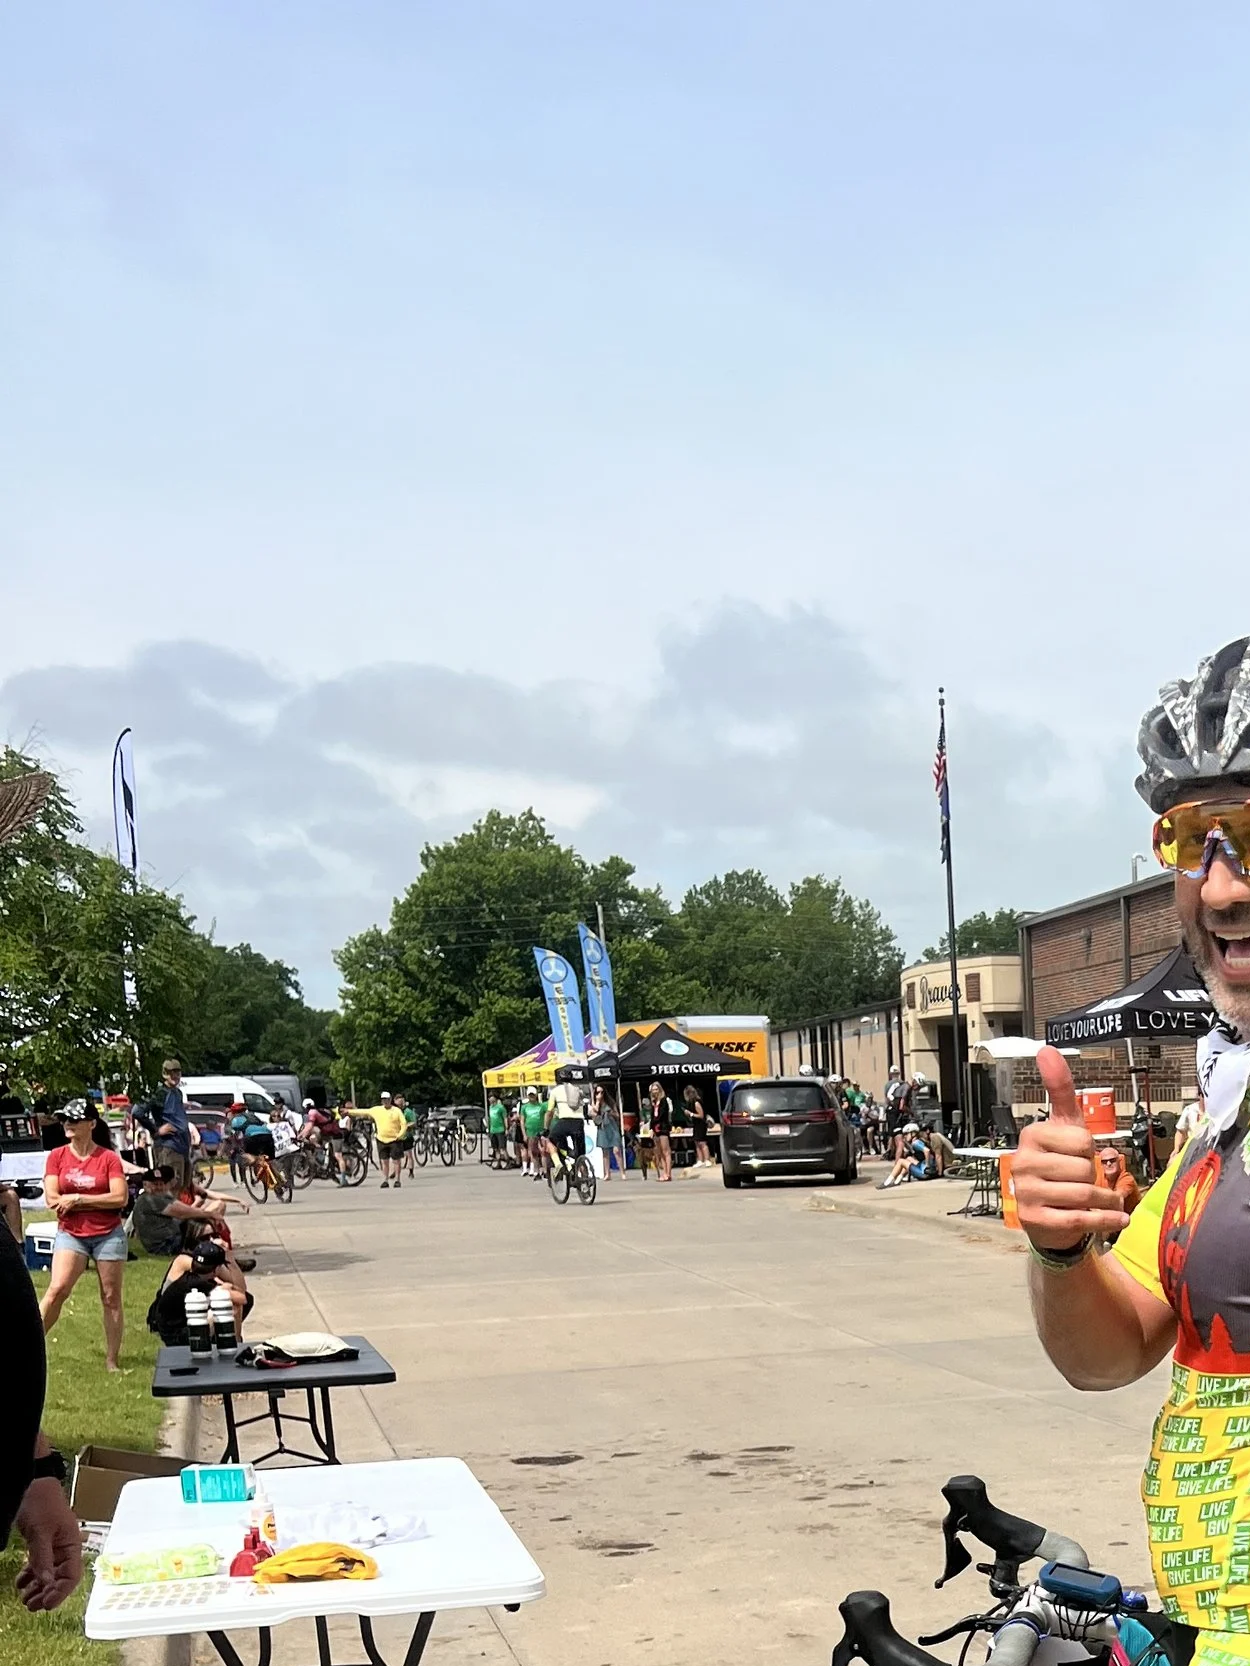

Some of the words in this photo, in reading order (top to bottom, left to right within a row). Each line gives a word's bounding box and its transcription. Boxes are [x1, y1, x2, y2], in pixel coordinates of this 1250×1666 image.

[700, 1041, 757, 1053] ENSKE
[658, 1064, 680, 1075] FEET
[681, 1063, 721, 1074] CYCLING
[1180, 1437, 1205, 1453] LIFE
[1175, 1461, 1199, 1478] LIVE
[1201, 1458, 1230, 1476] LIFE
[1178, 1478, 1203, 1497] GIVE
[1205, 1474, 1233, 1494] LIFE
[1160, 1507, 1178, 1523] LIFE
[1200, 1501, 1229, 1520] LIVE
[1163, 1525, 1182, 1541] LIFE
[1207, 1519, 1229, 1536] GIV
[1163, 1552, 1182, 1568] LIVE
[1185, 1547, 1211, 1566] LIFE
[1168, 1568, 1191, 1586] GIVE
[1194, 1564, 1221, 1582] LIFE
[1229, 1554, 1250, 1584] LIFE
[1197, 1589, 1219, 1607] LIV
